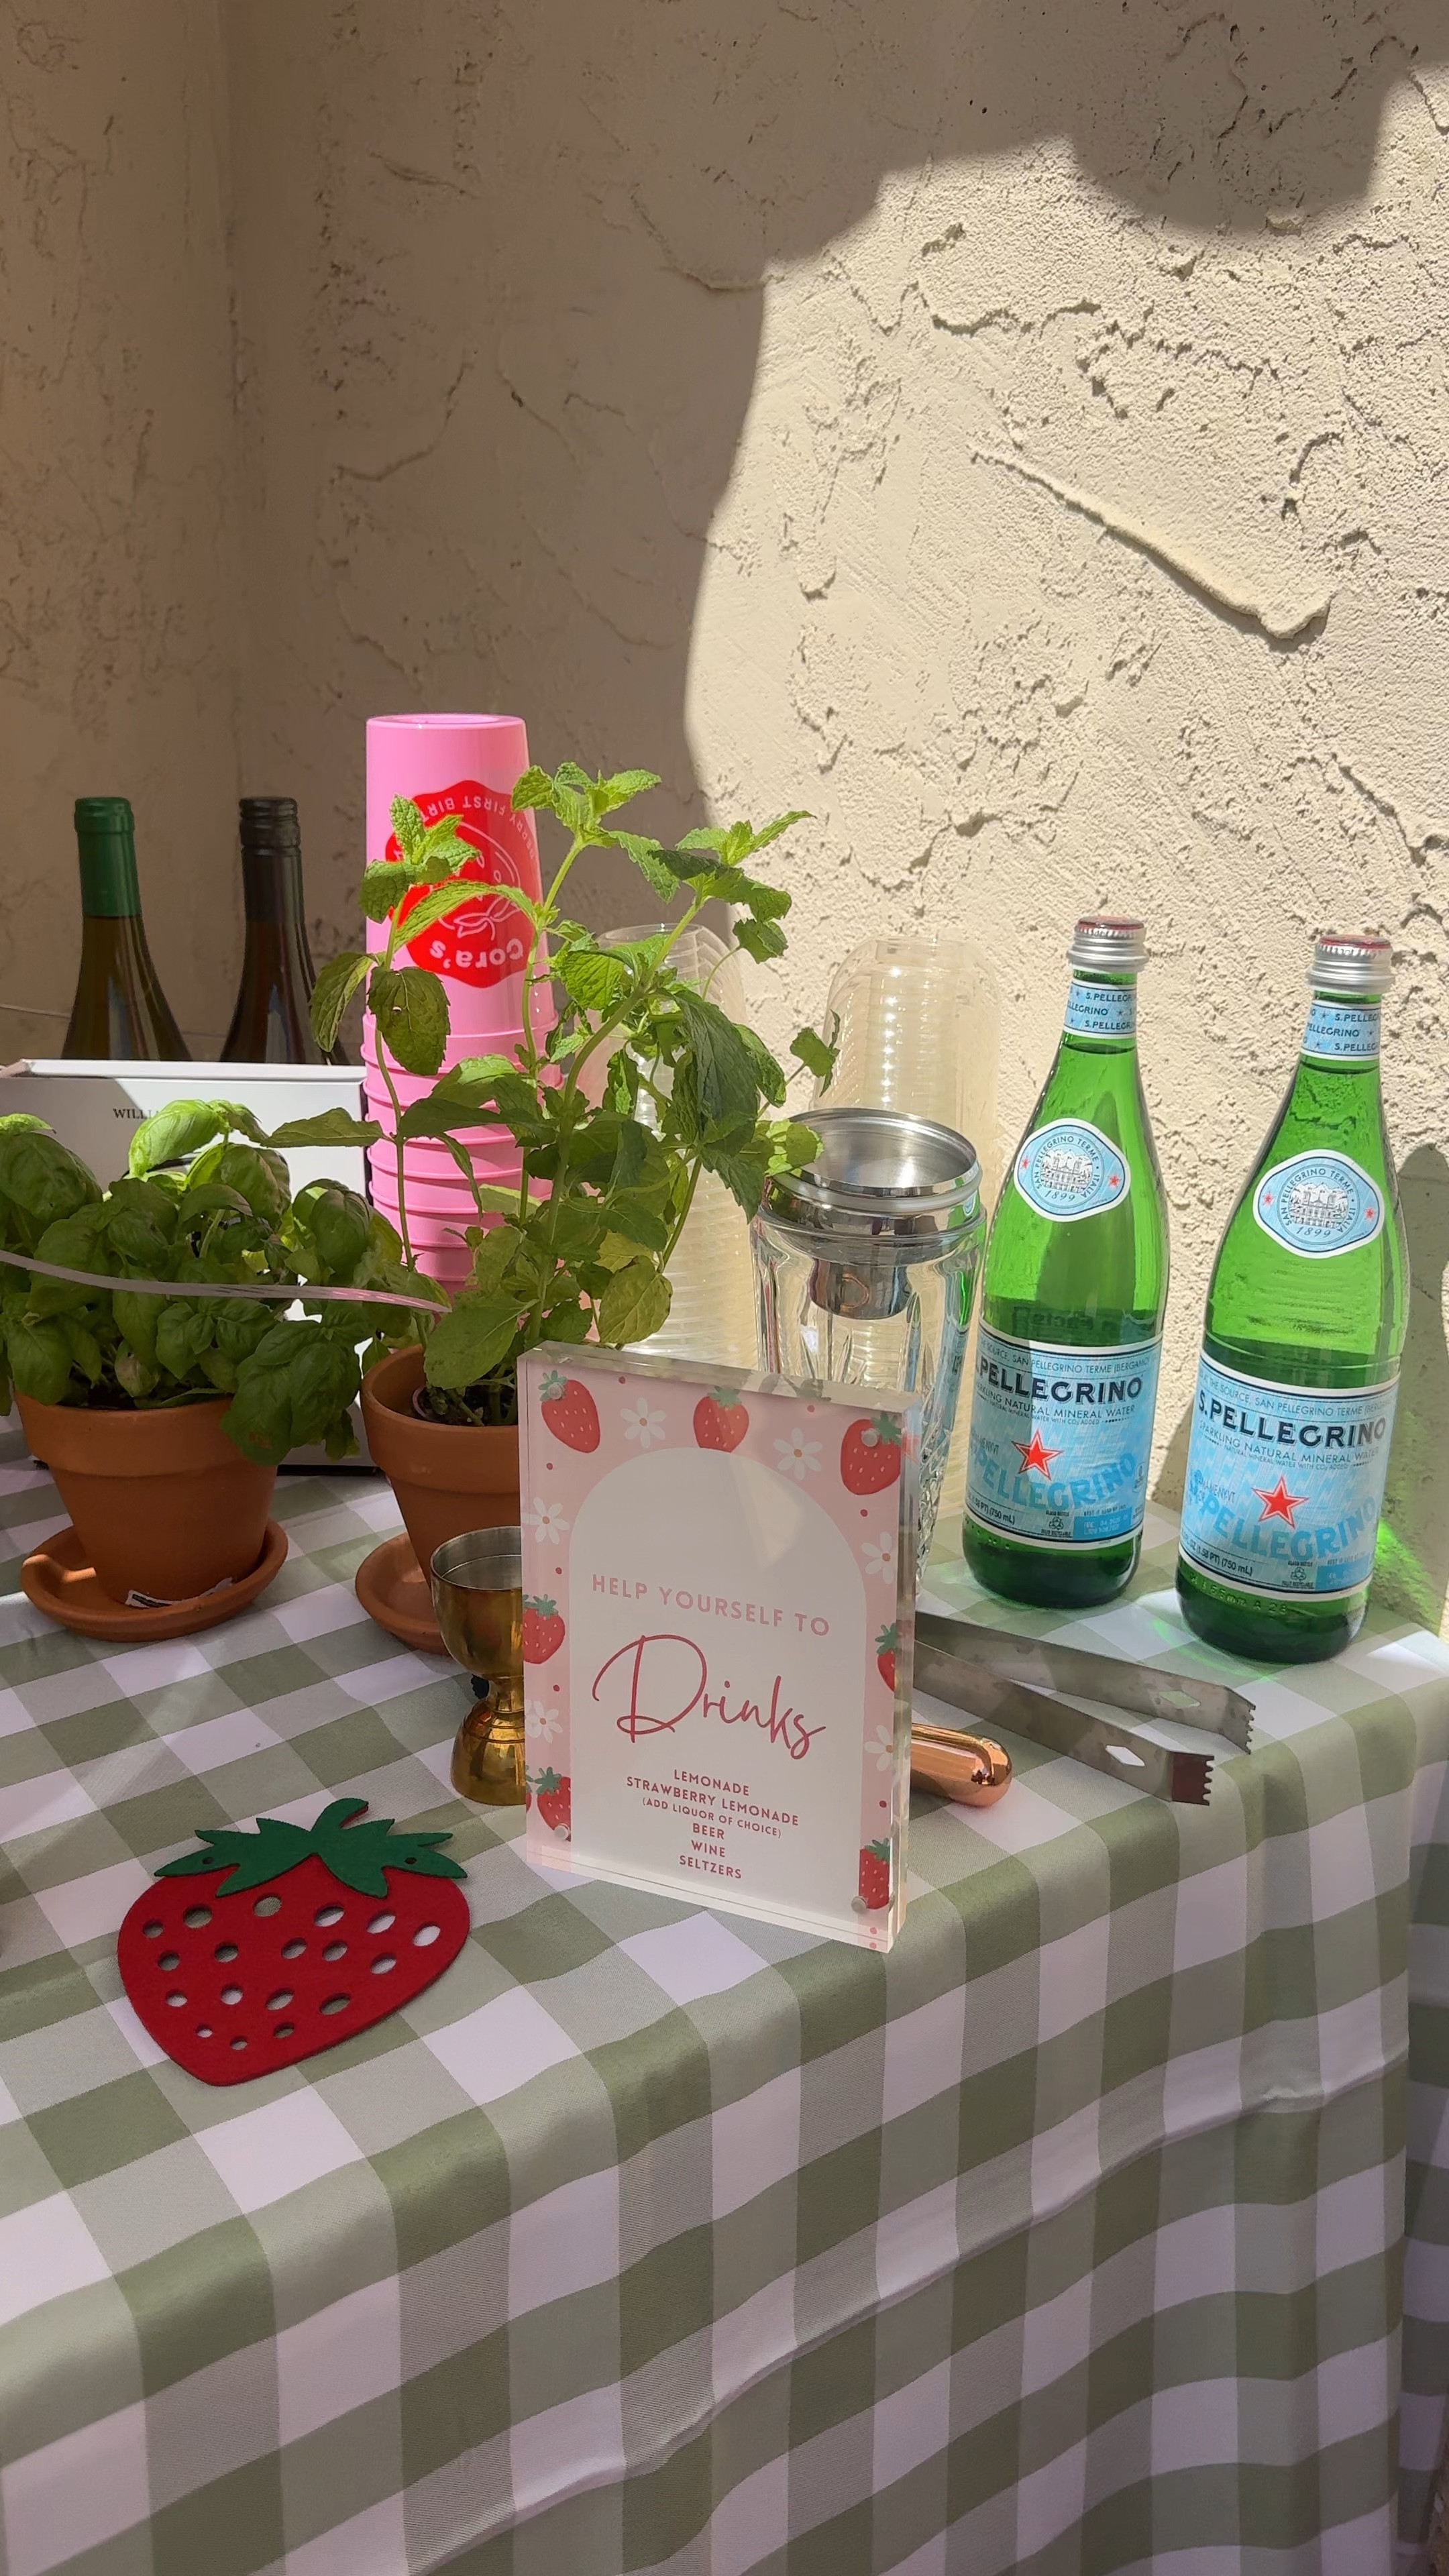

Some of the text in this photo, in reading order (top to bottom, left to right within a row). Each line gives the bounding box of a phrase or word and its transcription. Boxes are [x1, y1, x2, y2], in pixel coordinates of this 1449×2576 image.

[462, 796, 505, 816] FIRST
[113, 1108, 158, 1119] WILLI
[1036, 1136, 1073, 1168] PELLEGRINO
[1077, 1138, 1099, 1162] TERME
[1044, 1189, 1075, 1202] 1899
[1081, 1175, 1099, 1198] ITALIA
[1281, 1168, 1356, 1232] SAN PELLEGRINO TERME ITALIA
[1296, 1226, 1331, 1238] 1899
[1012, 1354, 1028, 1366] SAN
[1032, 1359, 1082, 1373] PELLEGRINO
[1085, 1365, 1112, 1373] TERME
[1006, 1398, 1049, 1415] NATURAL
[1054, 1409, 1102, 1419] MINERAL
[1107, 1405, 1135, 1417] WATER
[1255, 1397, 1274, 1409] SAN
[1278, 1402, 1334, 1415] PELLEGRINO
[1337, 1406, 1362, 1416] TERME
[1199, 1389, 1386, 1448] S.PELLEGRINO
[1245, 1444, 1296, 1461] NATURAL
[1301, 1454, 1350, 1464] MINERAL
[1354, 1448, 1379, 1460] WATER
[1003, 1514, 1015, 1525] mL)
[1222, 1558, 1236, 1570] (750
[1238, 1565, 1252, 1576] mL)
[592, 1574, 829, 1636] HELP YOURSELF TO
[592, 1633, 826, 1760] Drinks
[674, 1769, 749, 1796] LEMONADE
[627, 1776, 799, 1826] STRAWBERRY LEMONADE
[643, 1797, 782, 1839] (ADD LIQUOR OF CHOICE)
[693, 1823, 724, 1839] BEER
[691, 1839, 725, 1858] WINE
[680, 1855, 741, 1879] SELTZERS
